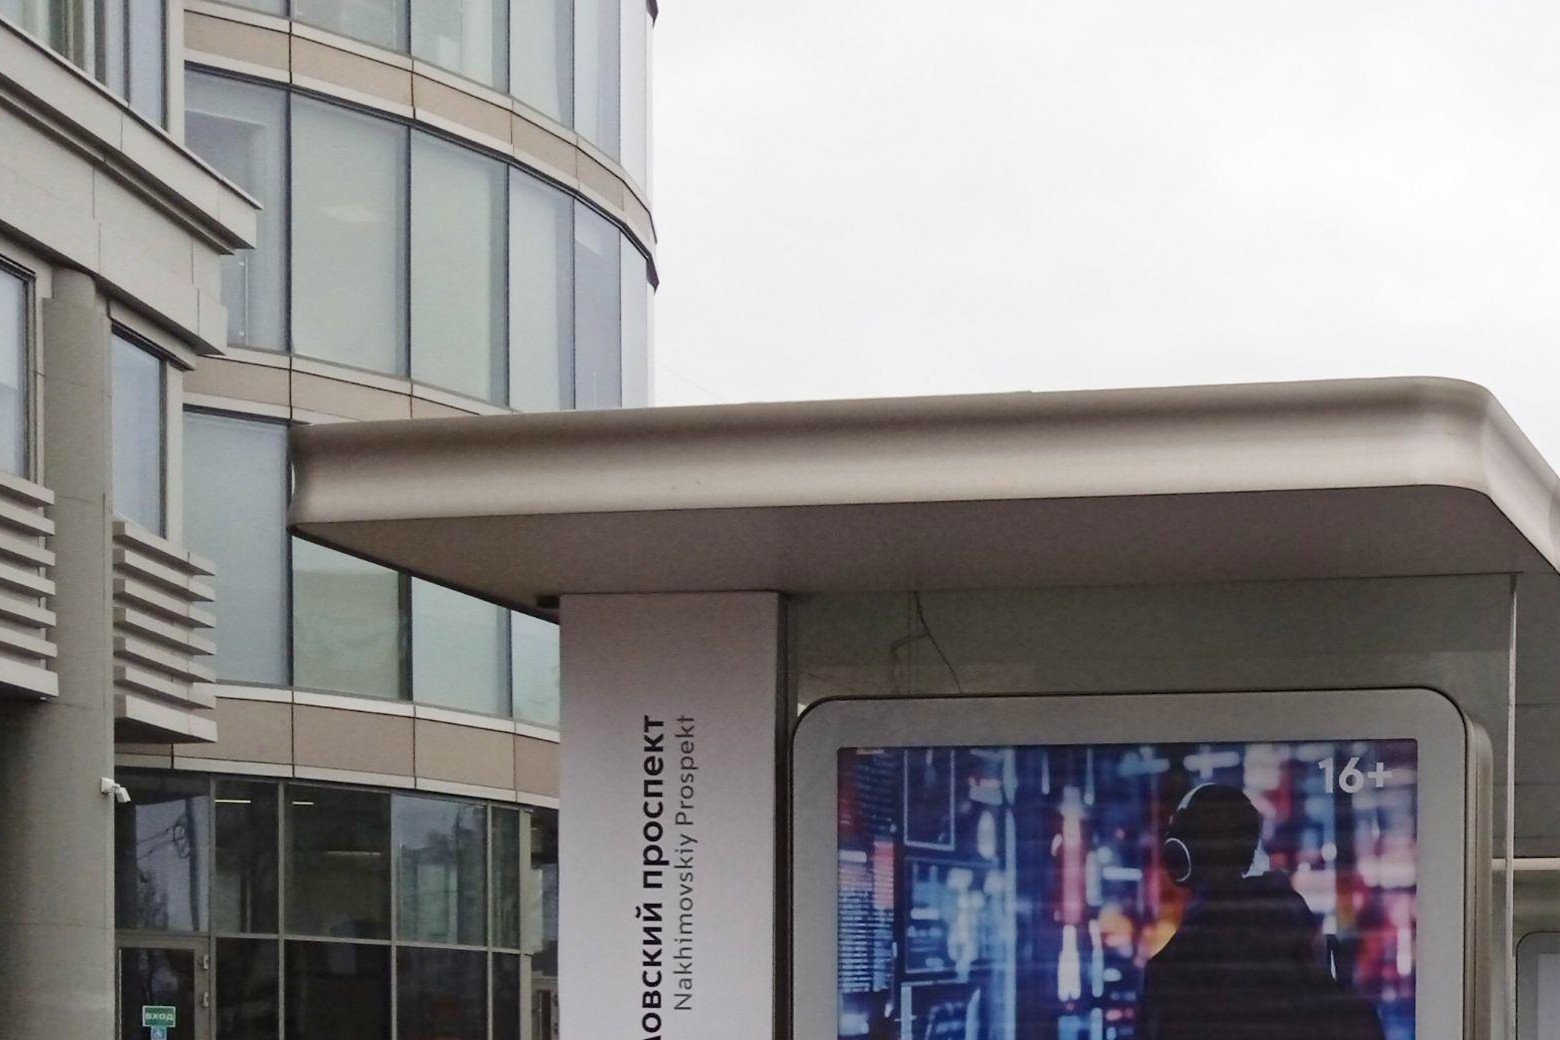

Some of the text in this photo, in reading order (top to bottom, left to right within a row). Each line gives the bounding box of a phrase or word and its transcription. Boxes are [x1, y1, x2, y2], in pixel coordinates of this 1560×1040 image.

[643, 714, 670, 889] проспект
[673, 714, 699, 1011] Nakhimovskiy Prospekt
[1317, 756, 1393, 794] 16+
